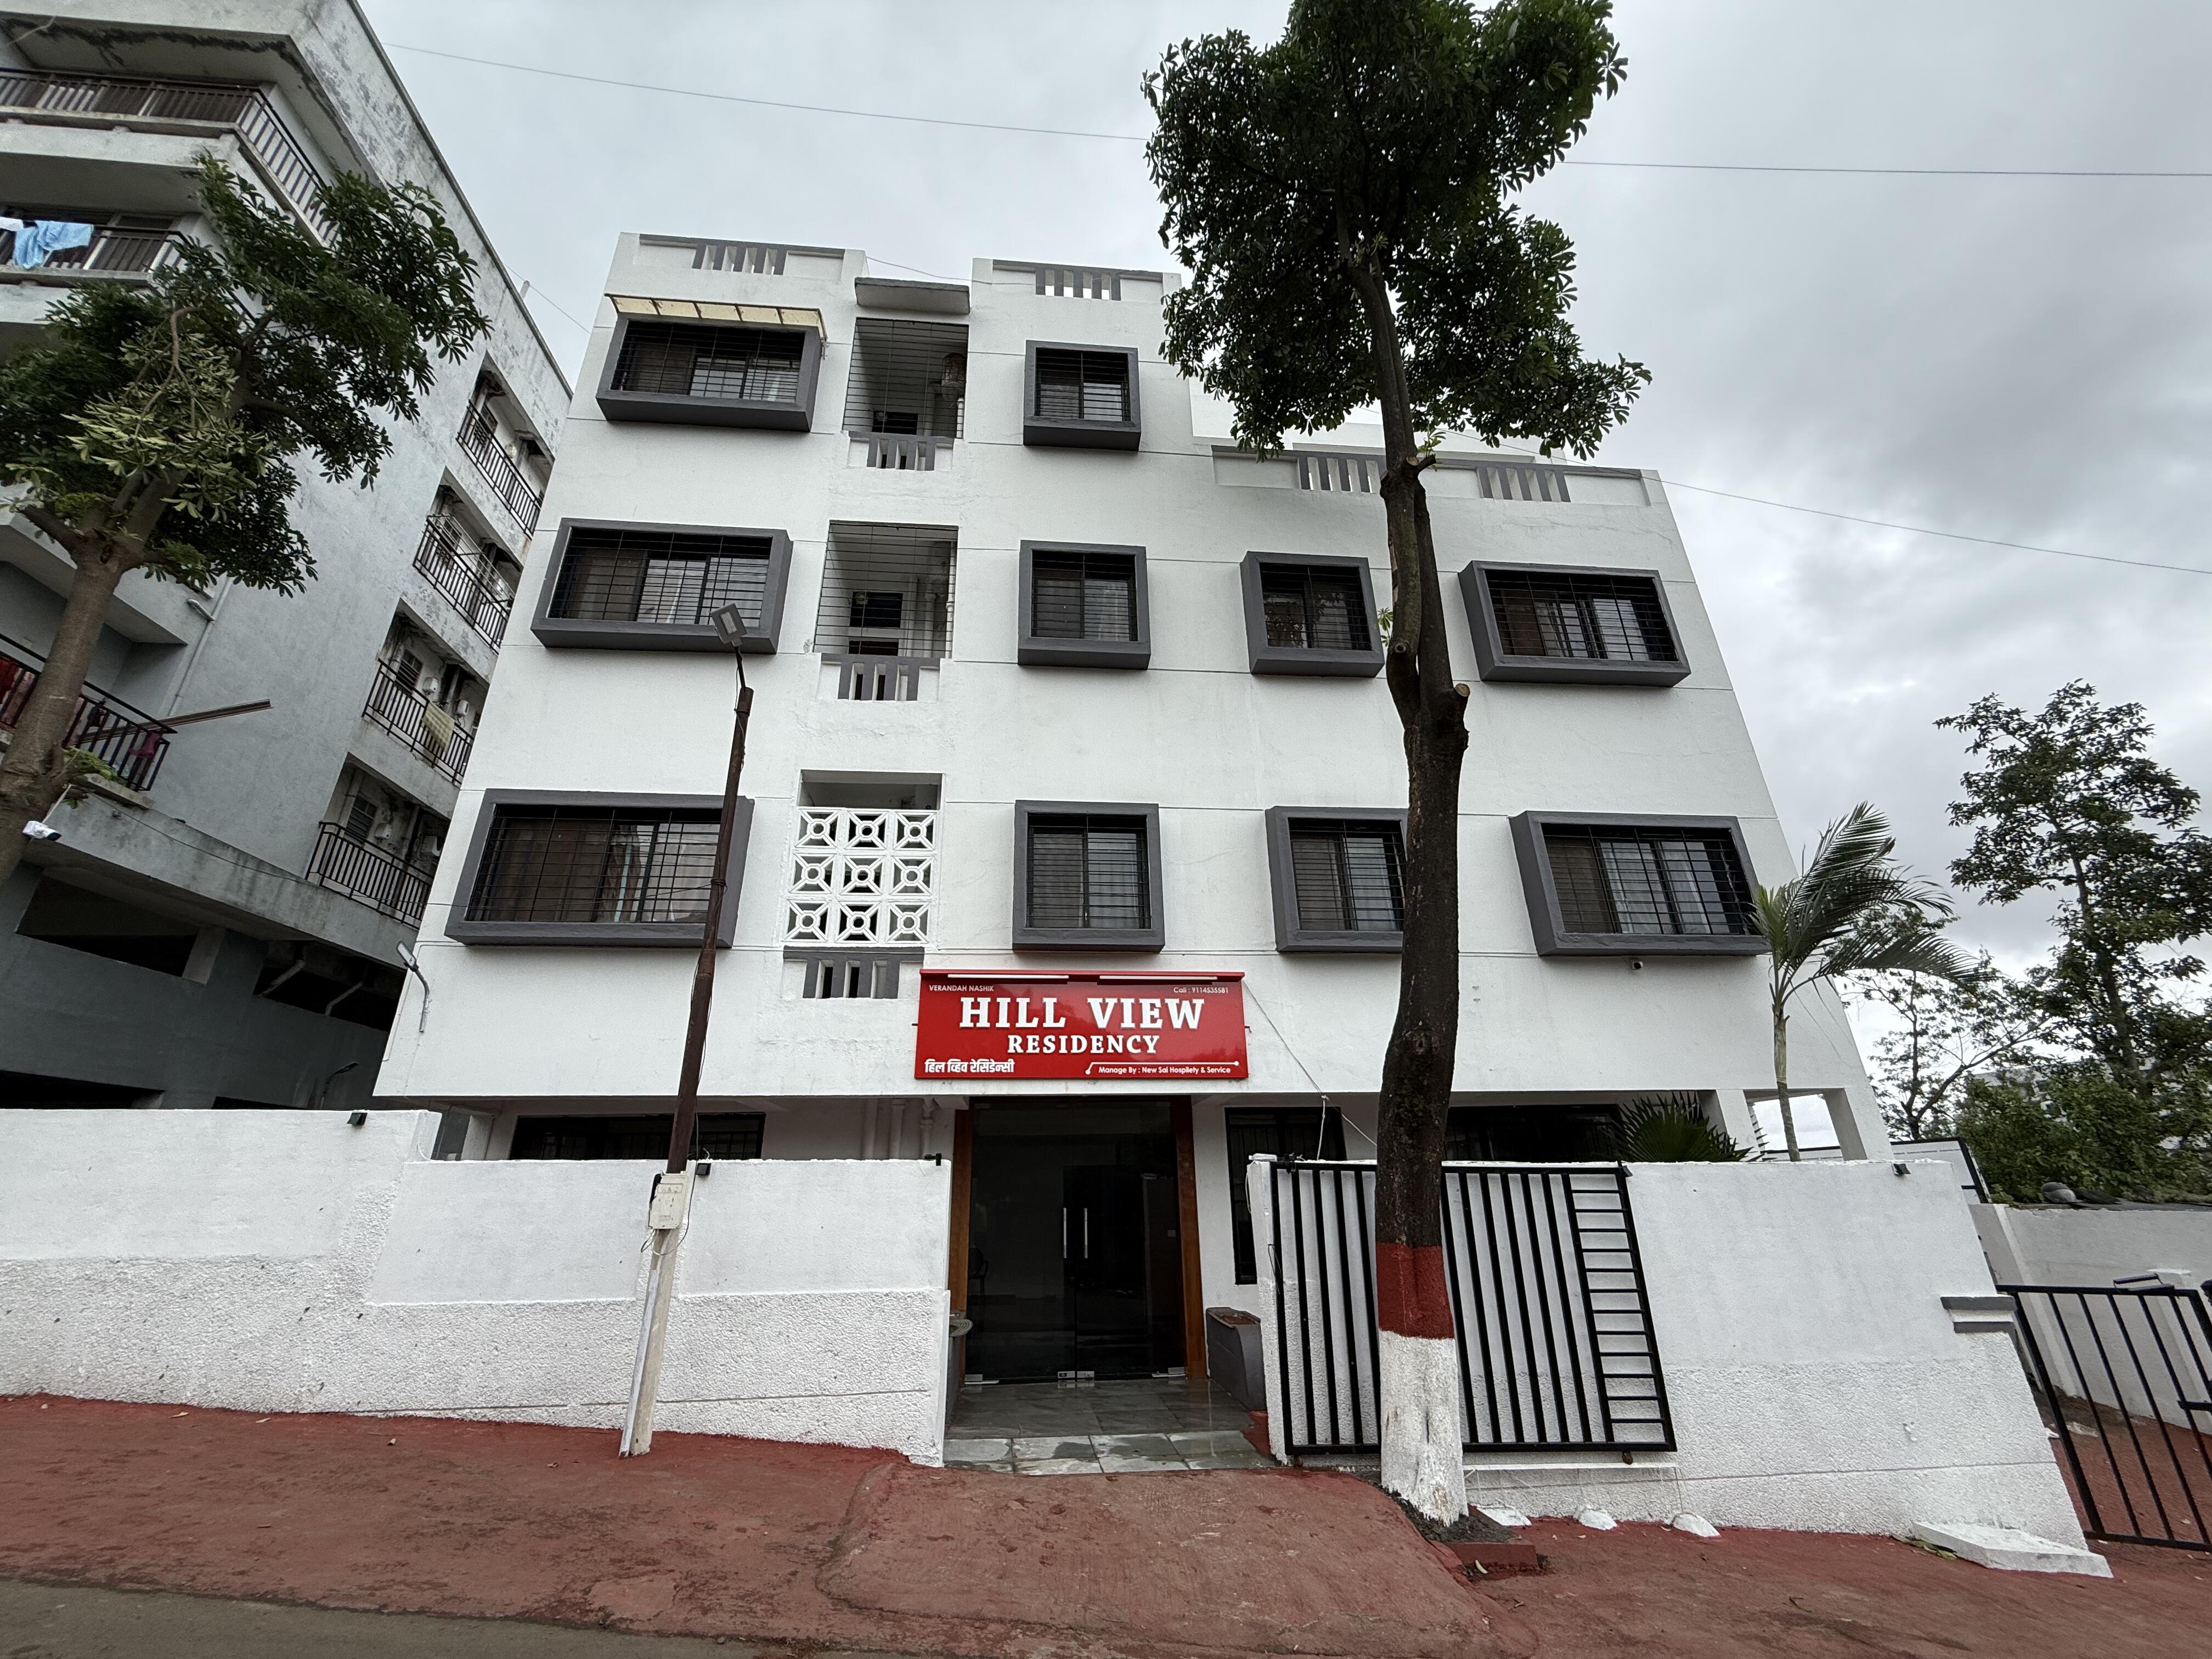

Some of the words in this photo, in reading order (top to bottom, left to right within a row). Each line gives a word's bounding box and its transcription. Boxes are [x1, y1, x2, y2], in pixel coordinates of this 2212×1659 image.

[959, 997, 1066, 1028] HILL
[1086, 997, 1205, 1030] VIEW
[1007, 1035, 1160, 1054] RESIDENCY
[924, 1058, 946, 1073] हिल
[947, 1058, 969, 1073] व्हिव
[969, 1058, 1015, 1073] रेसिडेन्सी
[1098, 1066, 1127, 1075] Manage
[1128, 1066, 1137, 1075] By
